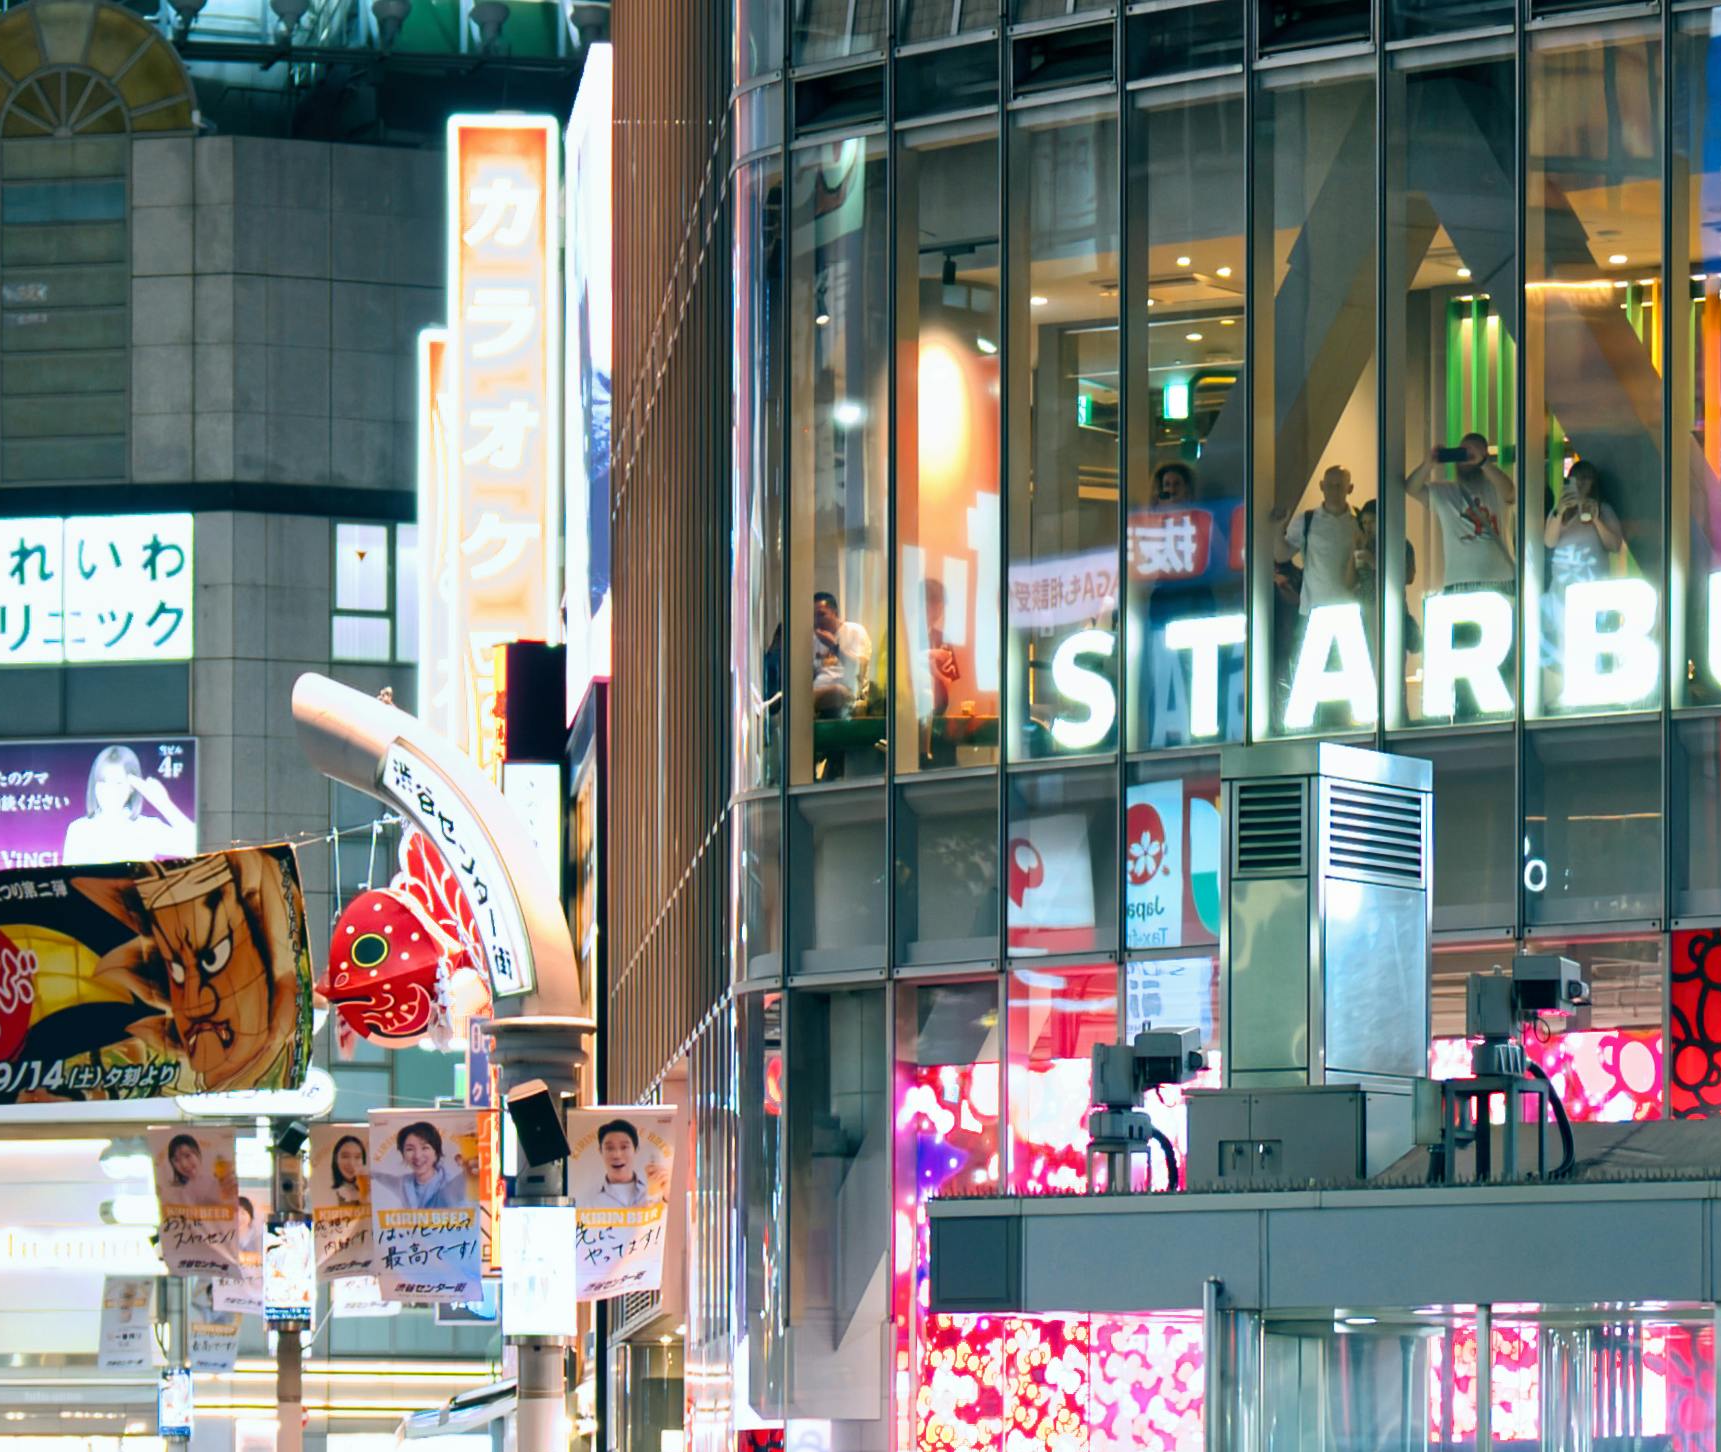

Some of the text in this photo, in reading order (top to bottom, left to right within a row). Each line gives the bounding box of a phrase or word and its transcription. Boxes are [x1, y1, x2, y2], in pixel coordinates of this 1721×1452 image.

[8, 532, 186, 586] れいわ
[157, 755, 184, 779] 4F
[0, 850, 59, 868] VINCI
[393, 758, 513, 980] 渋谷センター街
[385, 1209, 428, 1226] KIRIN
[581, 1207, 659, 1225] KIRIN BEER
[382, 1239, 478, 1270] 最高です!
